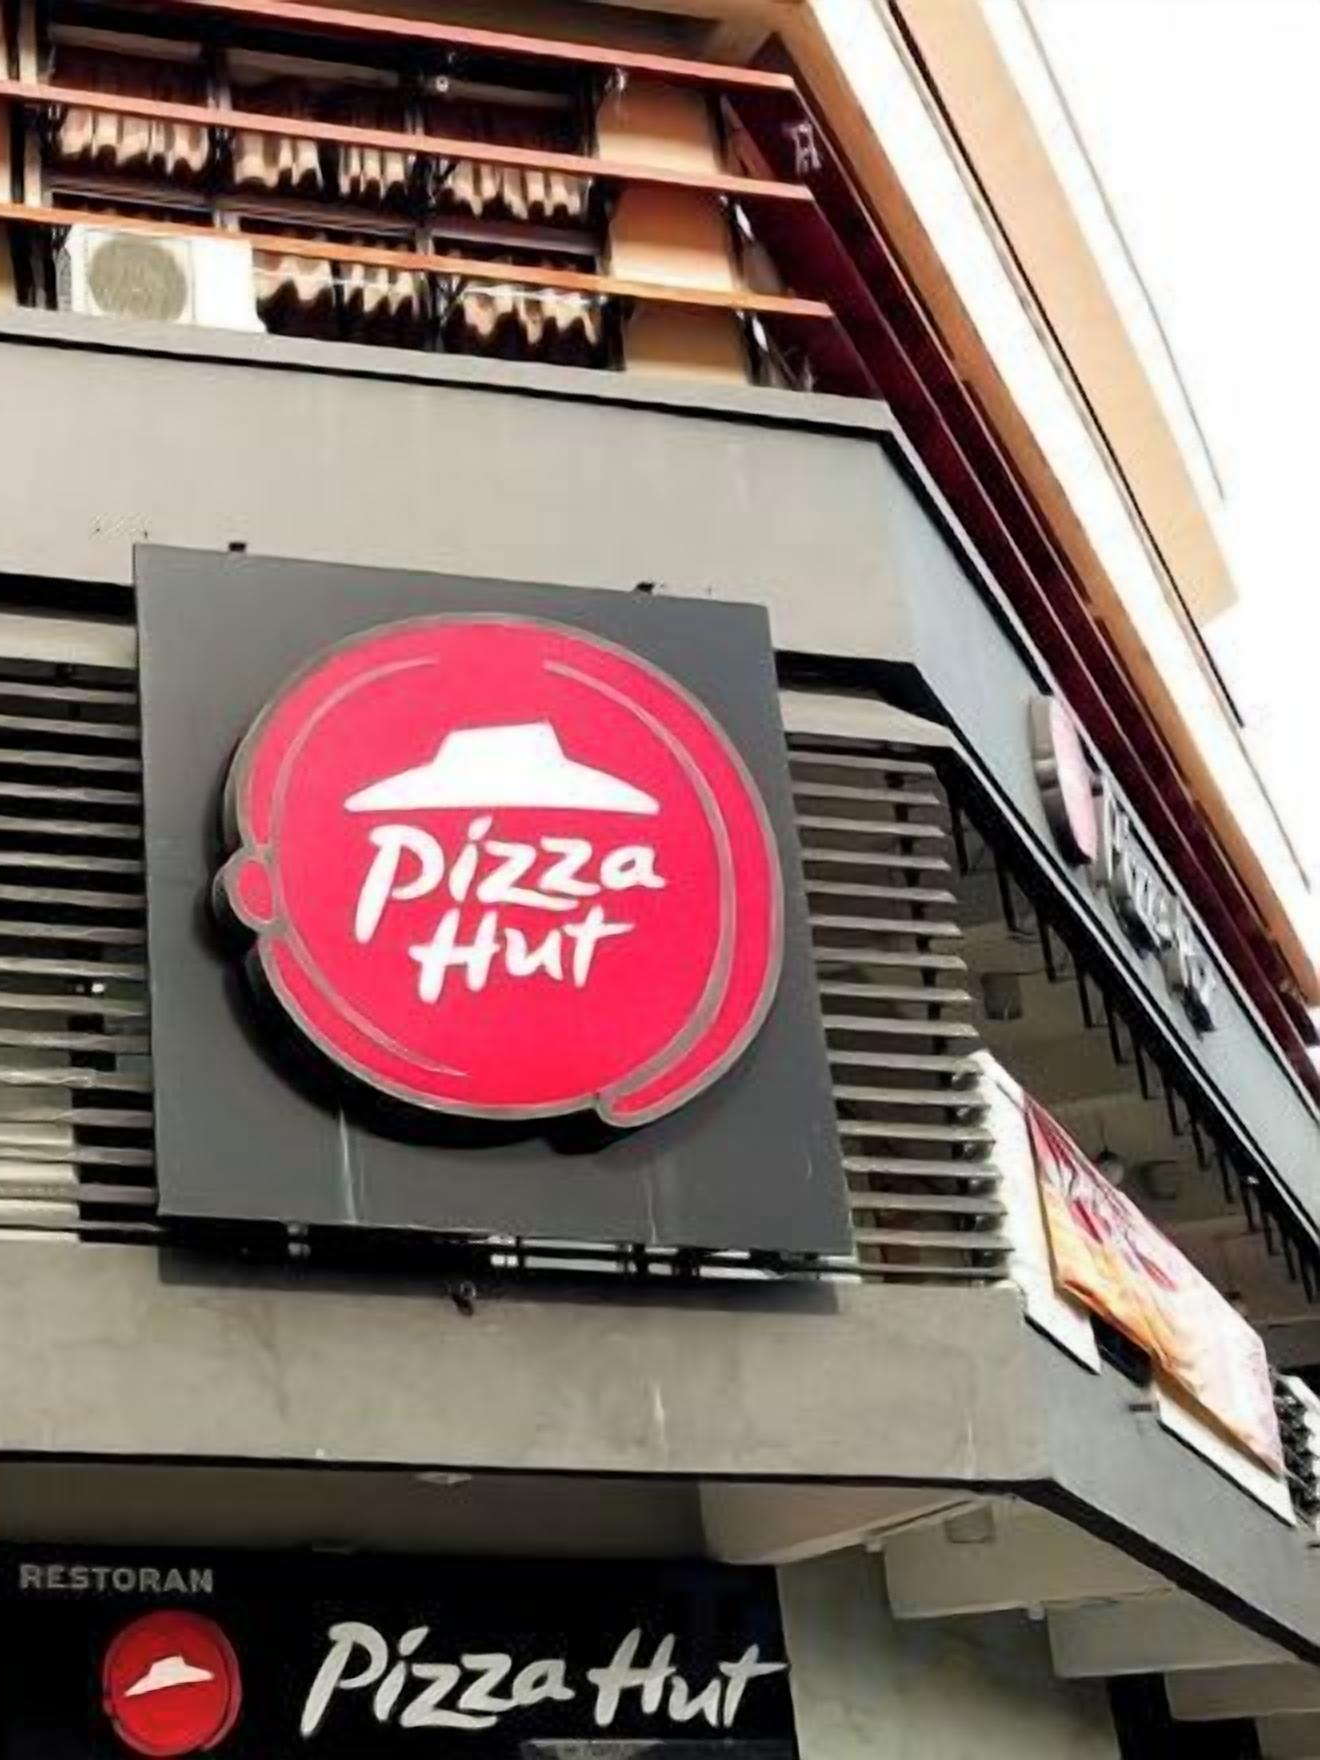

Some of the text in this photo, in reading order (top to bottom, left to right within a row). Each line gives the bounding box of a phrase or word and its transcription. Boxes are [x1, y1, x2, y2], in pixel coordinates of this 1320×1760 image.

[355, 815, 668, 945] Pizza
[408, 904, 636, 1005] Hut
[19, 1563, 214, 1593] RESTORAN
[300, 1621, 788, 1738] Pizza Hut
